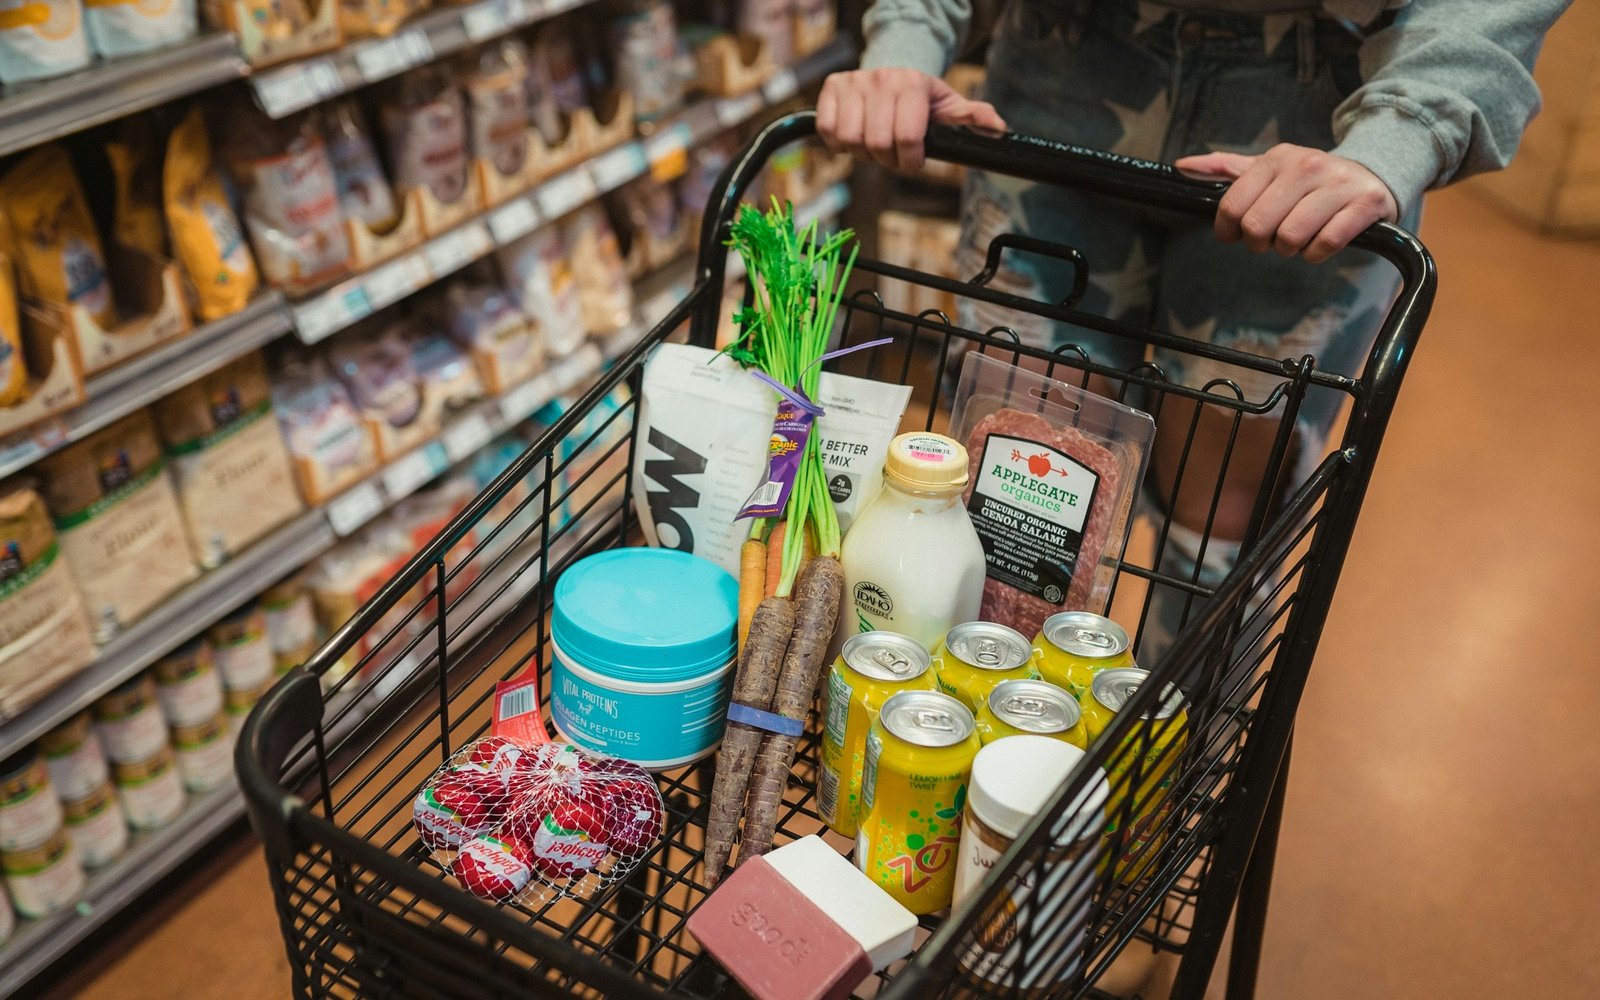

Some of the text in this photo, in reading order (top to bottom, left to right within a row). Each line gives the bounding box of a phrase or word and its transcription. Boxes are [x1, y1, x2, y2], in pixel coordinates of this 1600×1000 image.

[826, 440, 869, 456] BETTER
[829, 455, 850, 468] MIX
[991, 464, 1079, 507] APPLEGATE
[984, 498, 1068, 537] UNCURED ORGANIC
[981, 507, 1066, 547] GENOA SALAMI
[1044, 543, 1057, 551] those
[1056, 548, 1076, 558] naturally
[996, 559, 1007, 567] WT.
[857, 589, 890, 611] IDAHO
[562, 675, 579, 698] VITAL
[582, 688, 619, 719] PROTEINS
[590, 722, 641, 742] PEPTIDES
[909, 773, 941, 782] LEMON
[910, 782, 936, 790] TWIST
